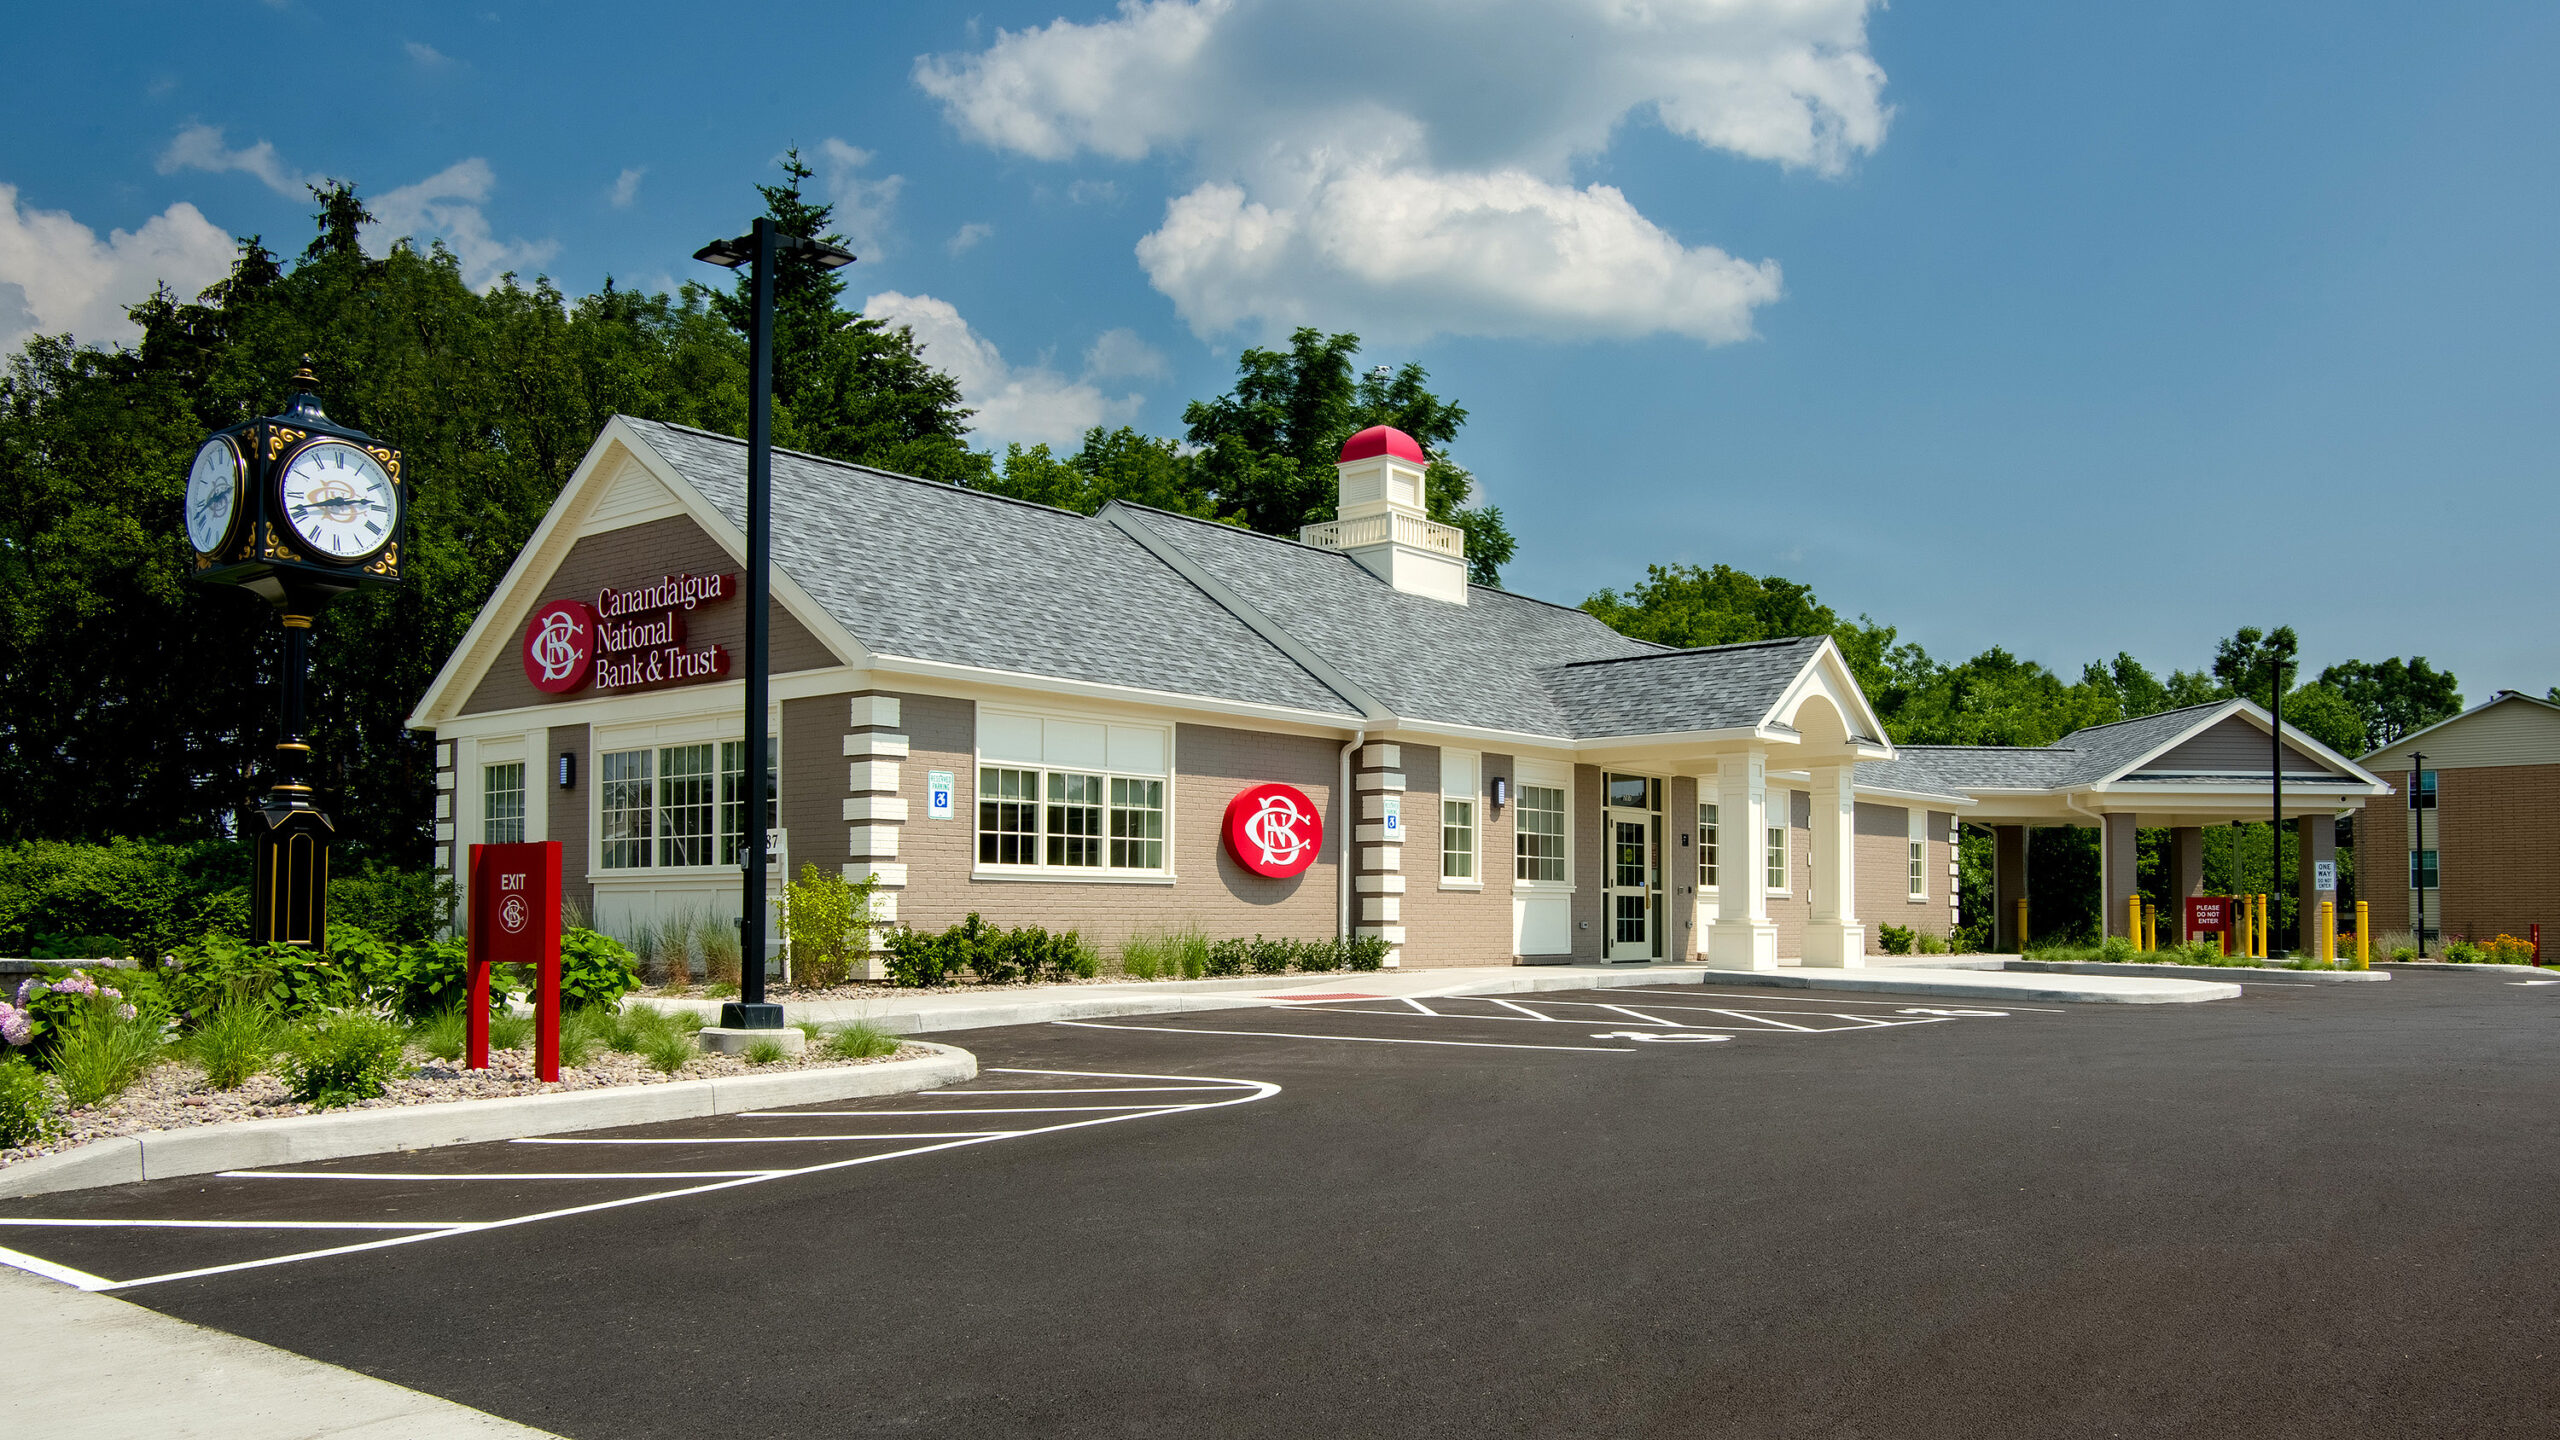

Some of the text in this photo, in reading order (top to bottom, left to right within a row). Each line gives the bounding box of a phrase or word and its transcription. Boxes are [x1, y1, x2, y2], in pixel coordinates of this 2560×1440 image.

[598, 573, 722, 619] Canandaigua
[597, 612, 673, 654] National
[596, 644, 718, 689] Bank & Trust
[501, 873, 526, 890] EXIT
